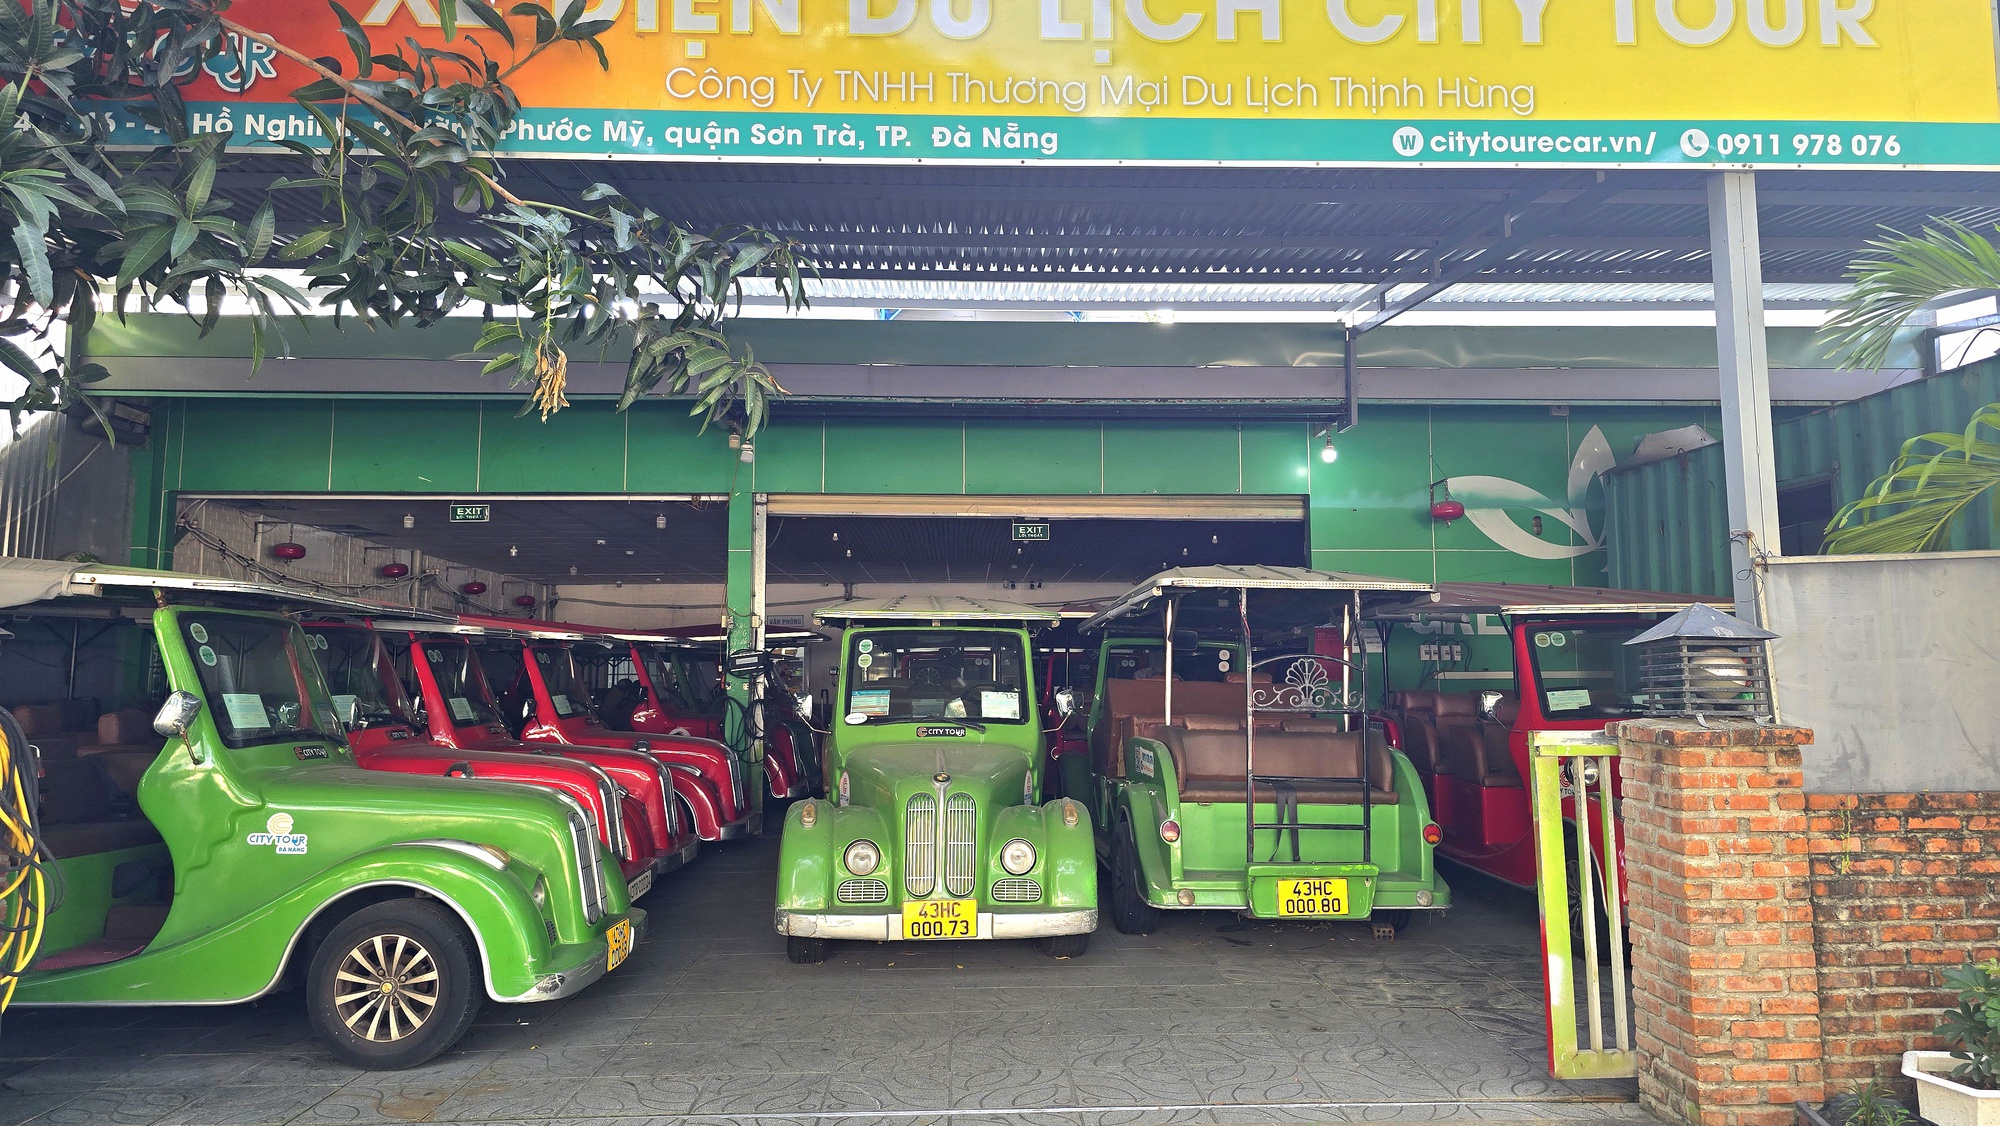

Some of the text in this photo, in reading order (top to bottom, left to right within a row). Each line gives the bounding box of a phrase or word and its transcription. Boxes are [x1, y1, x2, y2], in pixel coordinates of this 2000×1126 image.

[665, 67, 1535, 116] Công Ty TNHH Thương Mại Du Lịch Thịnh Hùng
[193, 107, 234, 134] Hồ
[603, 120, 654, 147] Mỹ,
[665, 121, 740, 150] quận
[751, 123, 802, 145] Sơn
[813, 123, 865, 150] Trà,
[876, 125, 911, 147] TP.
[932, 124, 971, 148] Đà
[982, 122, 1058, 155] Nẵng
[1430, 131, 1657, 156] citytourecar.vn/
[1717, 133, 1901, 157] 0911 978 076
[457, 507, 482, 515] EXIT
[1019, 526, 1043, 534] EXIT
[944, 728, 965, 737] TOUR
[249, 834, 305, 846] CITY TOUR
[1293, 881, 1332, 896] 43HC
[919, 902, 961, 918] 43HC
[1286, 898, 1341, 913] 000.80
[911, 920, 969, 937] 000.73
